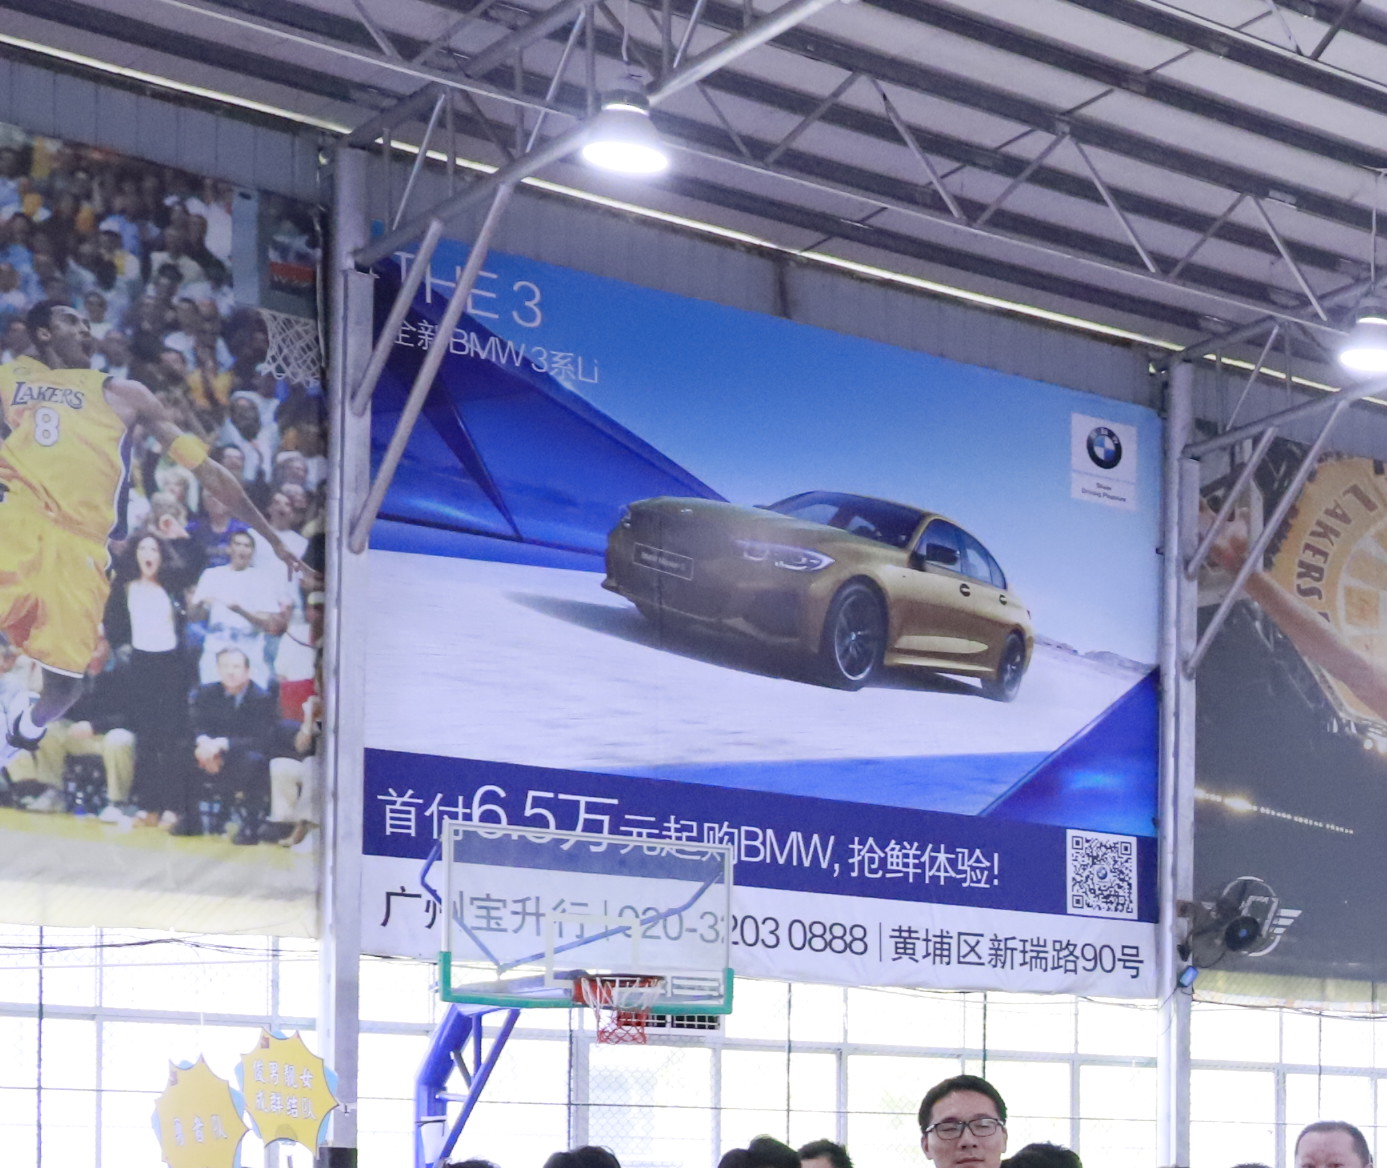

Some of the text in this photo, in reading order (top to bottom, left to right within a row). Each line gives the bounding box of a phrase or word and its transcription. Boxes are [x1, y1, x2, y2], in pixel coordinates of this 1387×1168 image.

[512, 281, 543, 328] 3
[10, 381, 86, 410] LAKERS
[34, 406, 59, 448] 8
[787, 917, 869, 956] 0888
[888, 924, 1145, 980] 黄埔区新瑞路90号
